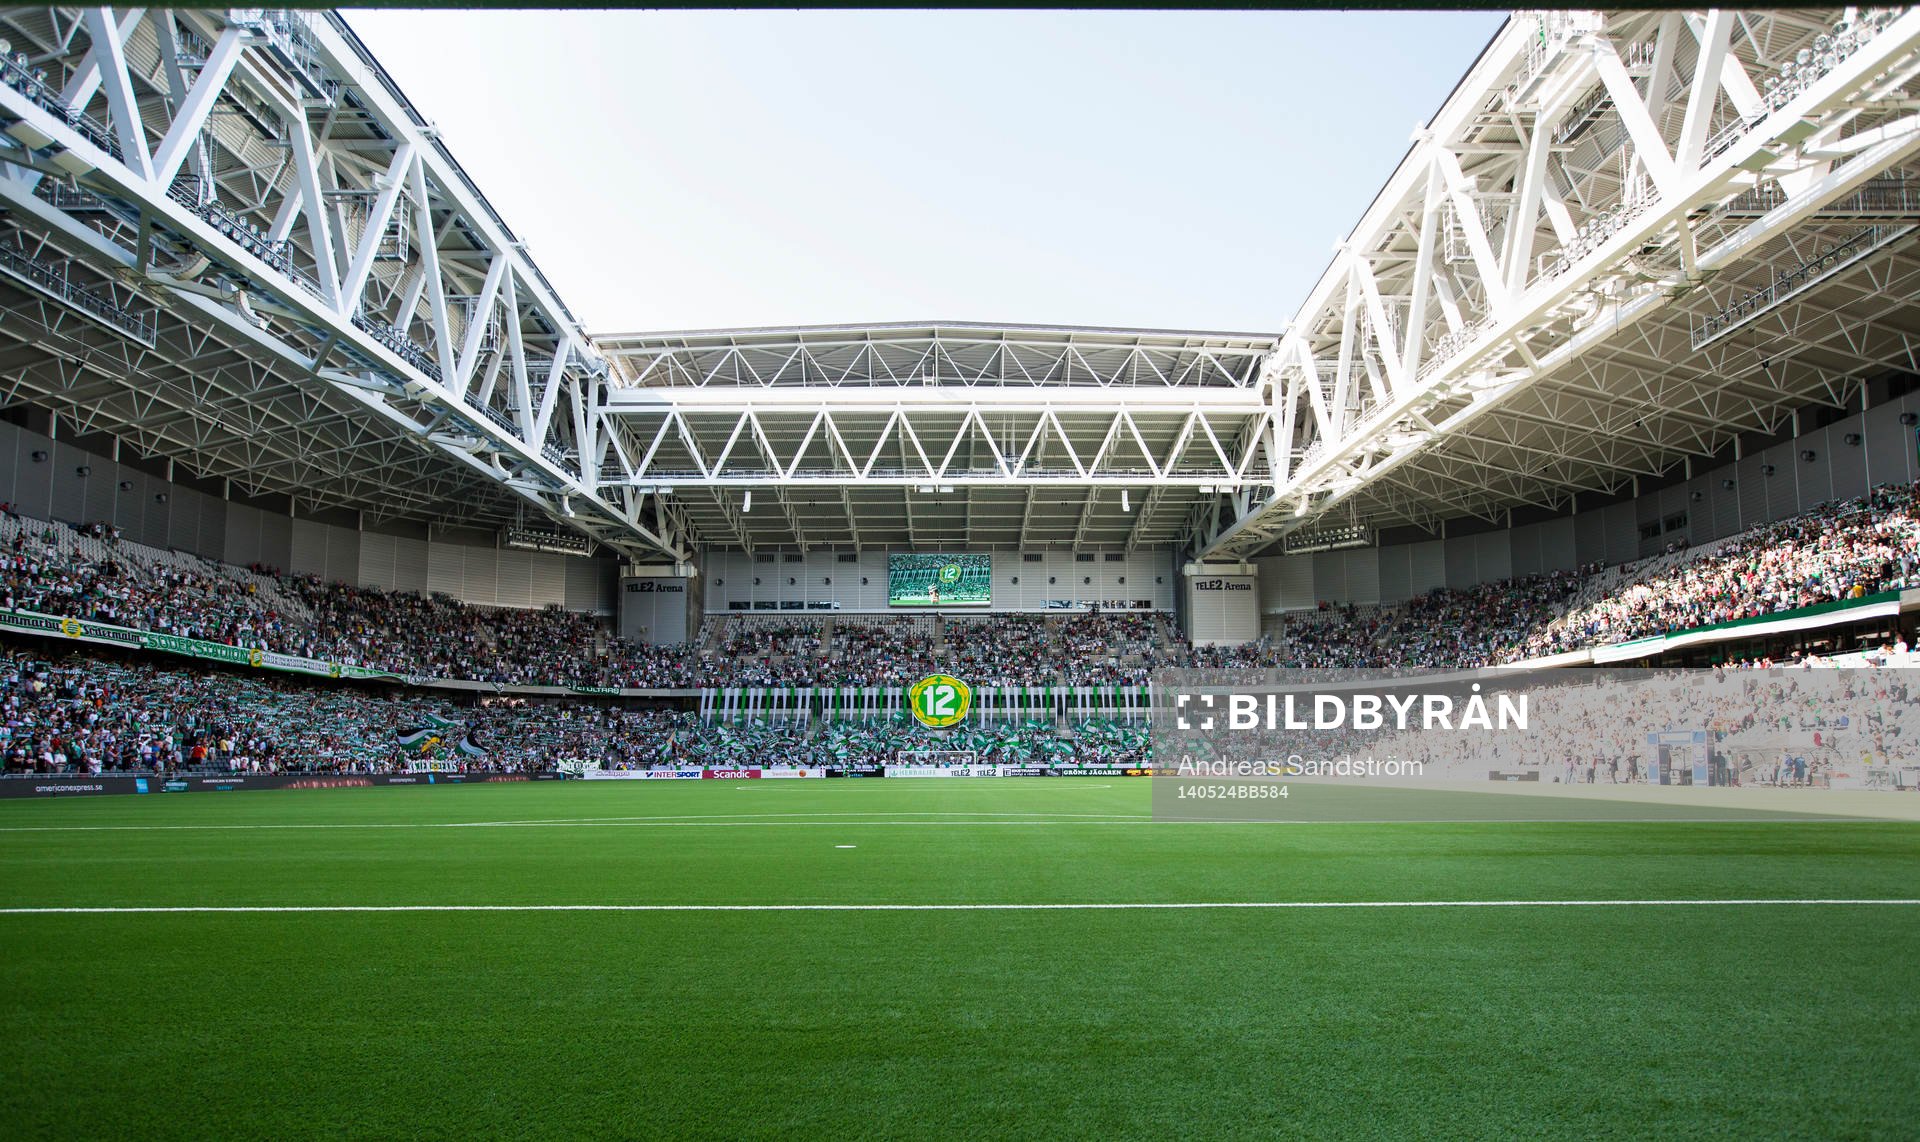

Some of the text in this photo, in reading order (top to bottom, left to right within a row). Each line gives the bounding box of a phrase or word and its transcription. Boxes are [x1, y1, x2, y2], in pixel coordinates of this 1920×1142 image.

[944, 568, 956, 579] 12
[626, 582, 683, 592] TELE2 Arena
[1195, 580, 1251, 591] TELE2 Arena
[923, 685, 955, 716] 12
[713, 770, 751, 778] Scandic
